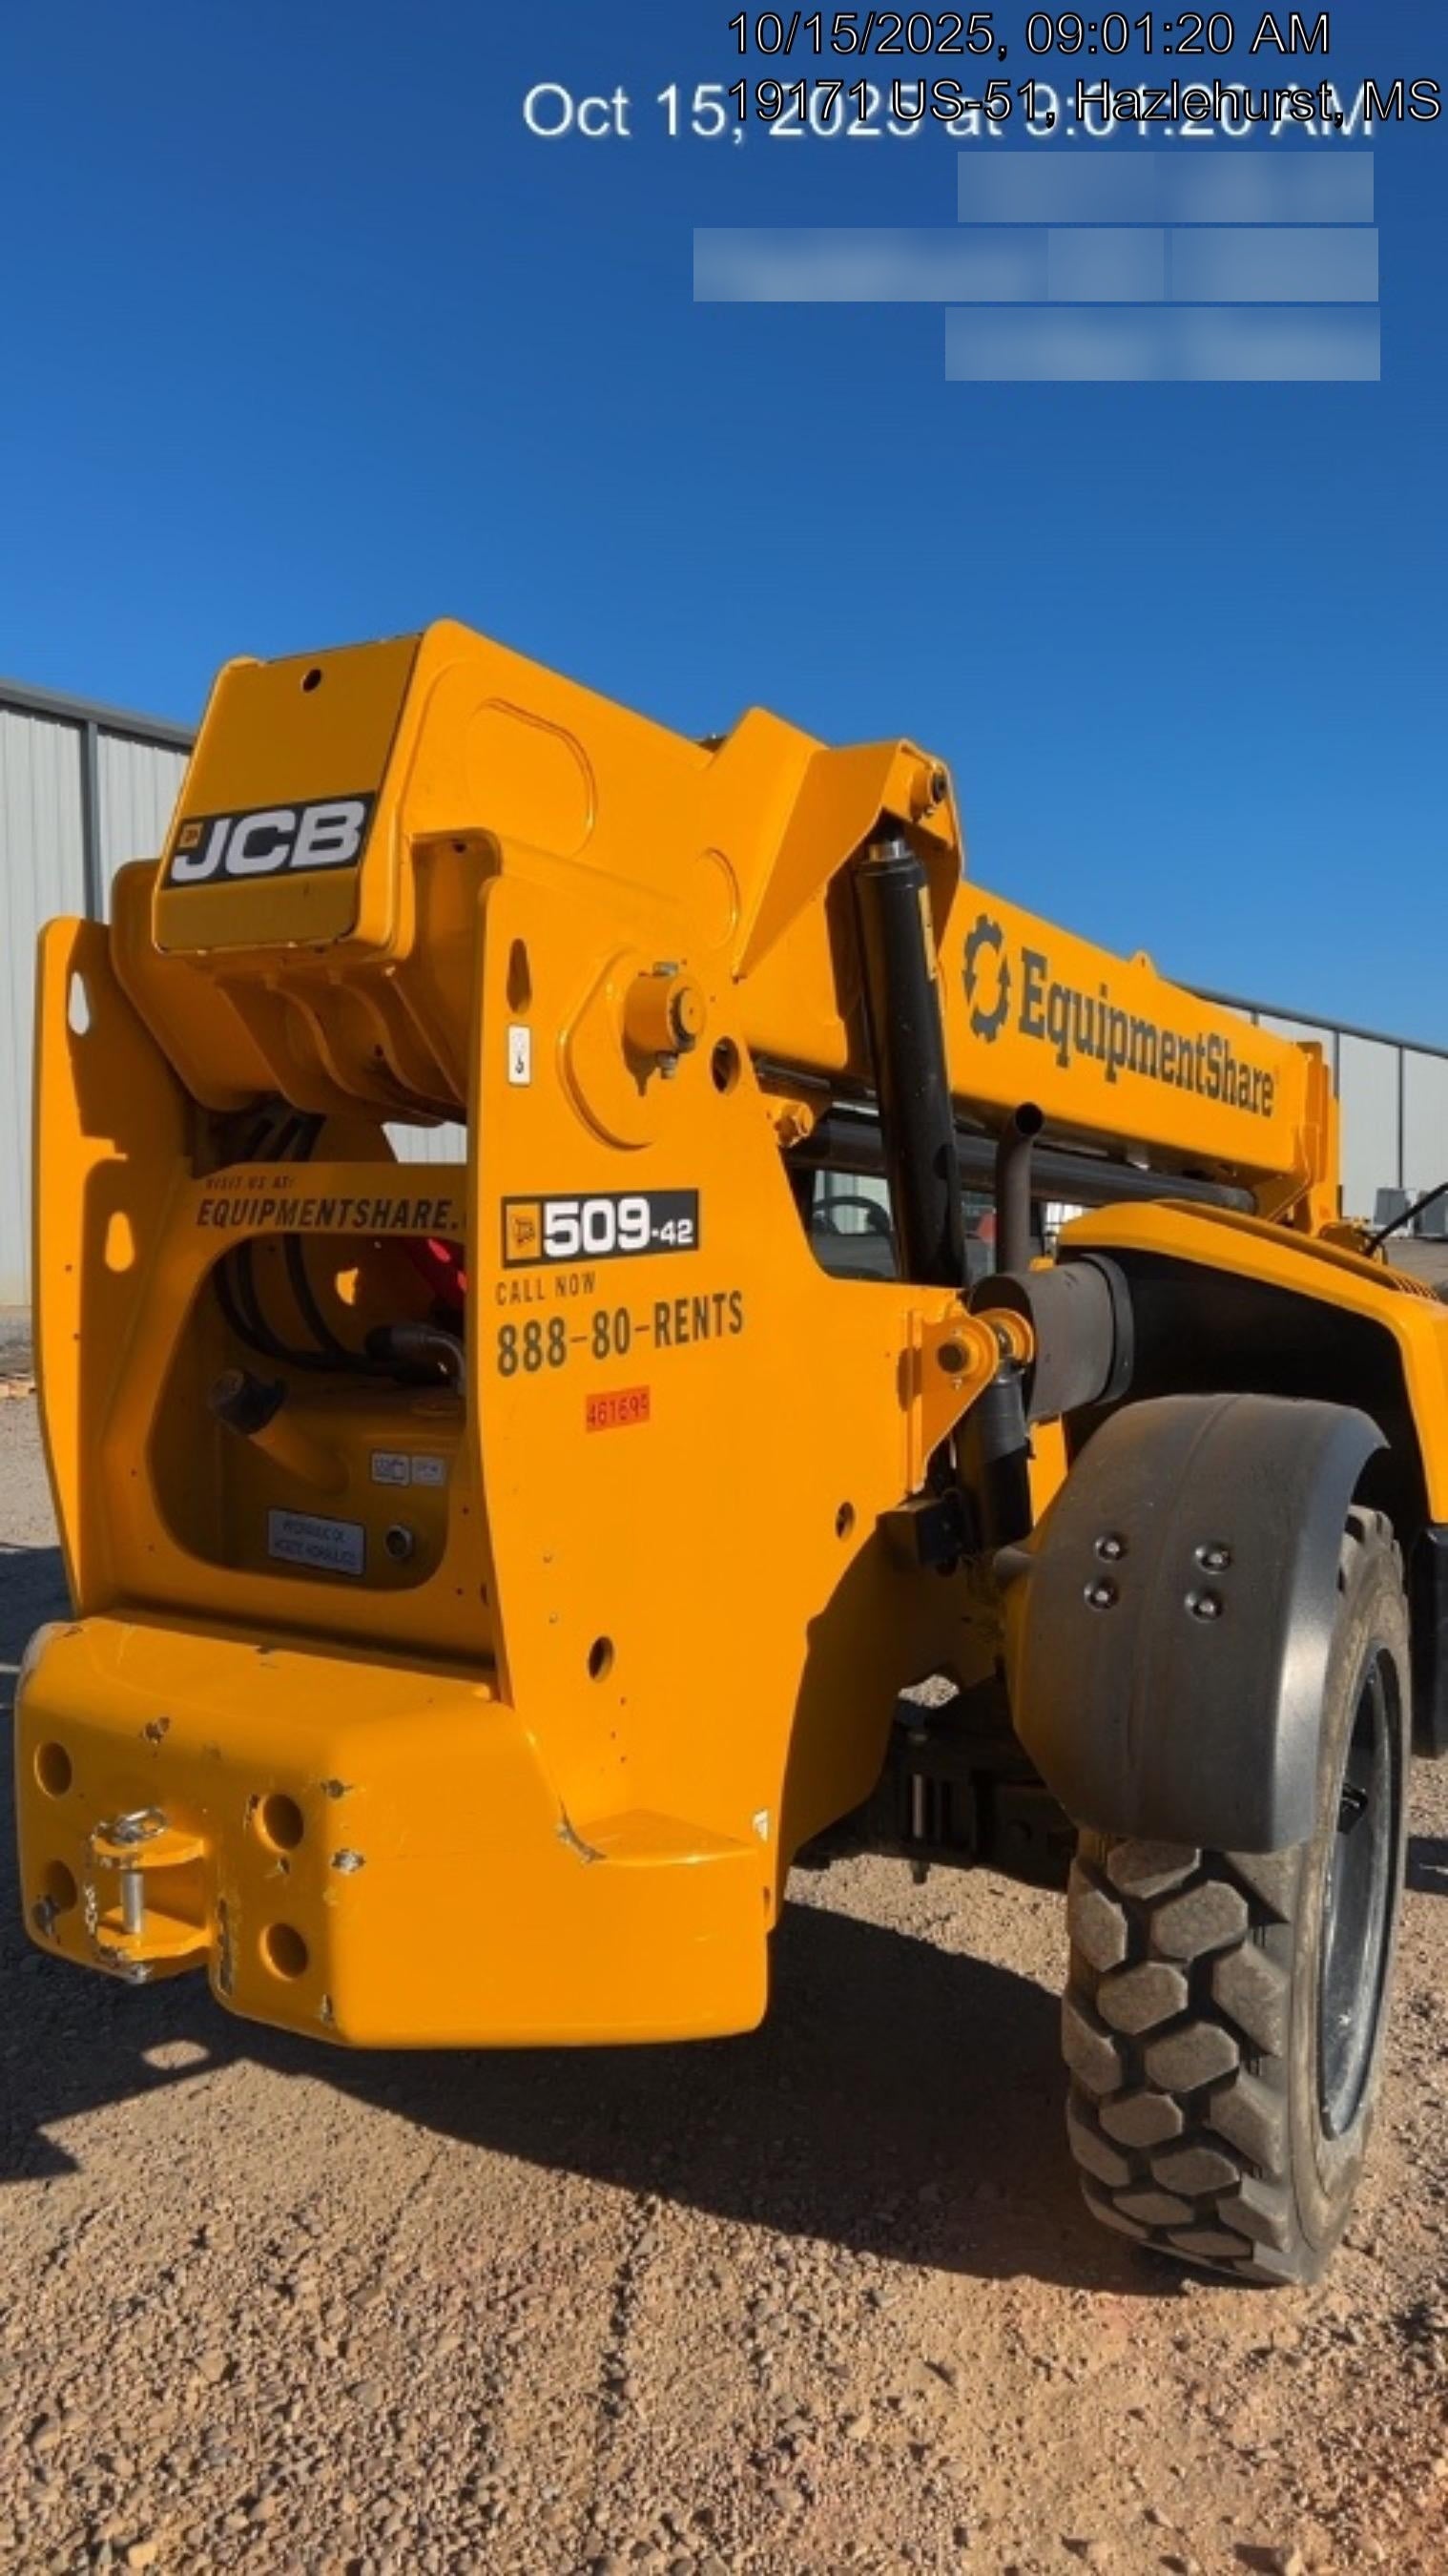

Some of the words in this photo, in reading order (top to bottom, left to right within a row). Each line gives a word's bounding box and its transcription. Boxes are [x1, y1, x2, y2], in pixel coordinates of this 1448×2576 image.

[170, 800, 365, 882] JCB
[1019, 946, 1274, 1117] EquipmentShare
[196, 1198, 467, 1229] EQUIPMENTSHARE.
[495, 1278, 547, 1305] CALL
[555, 1272, 595, 1298] NOW
[497, 1290, 743, 1378] 888-80-RENTS
